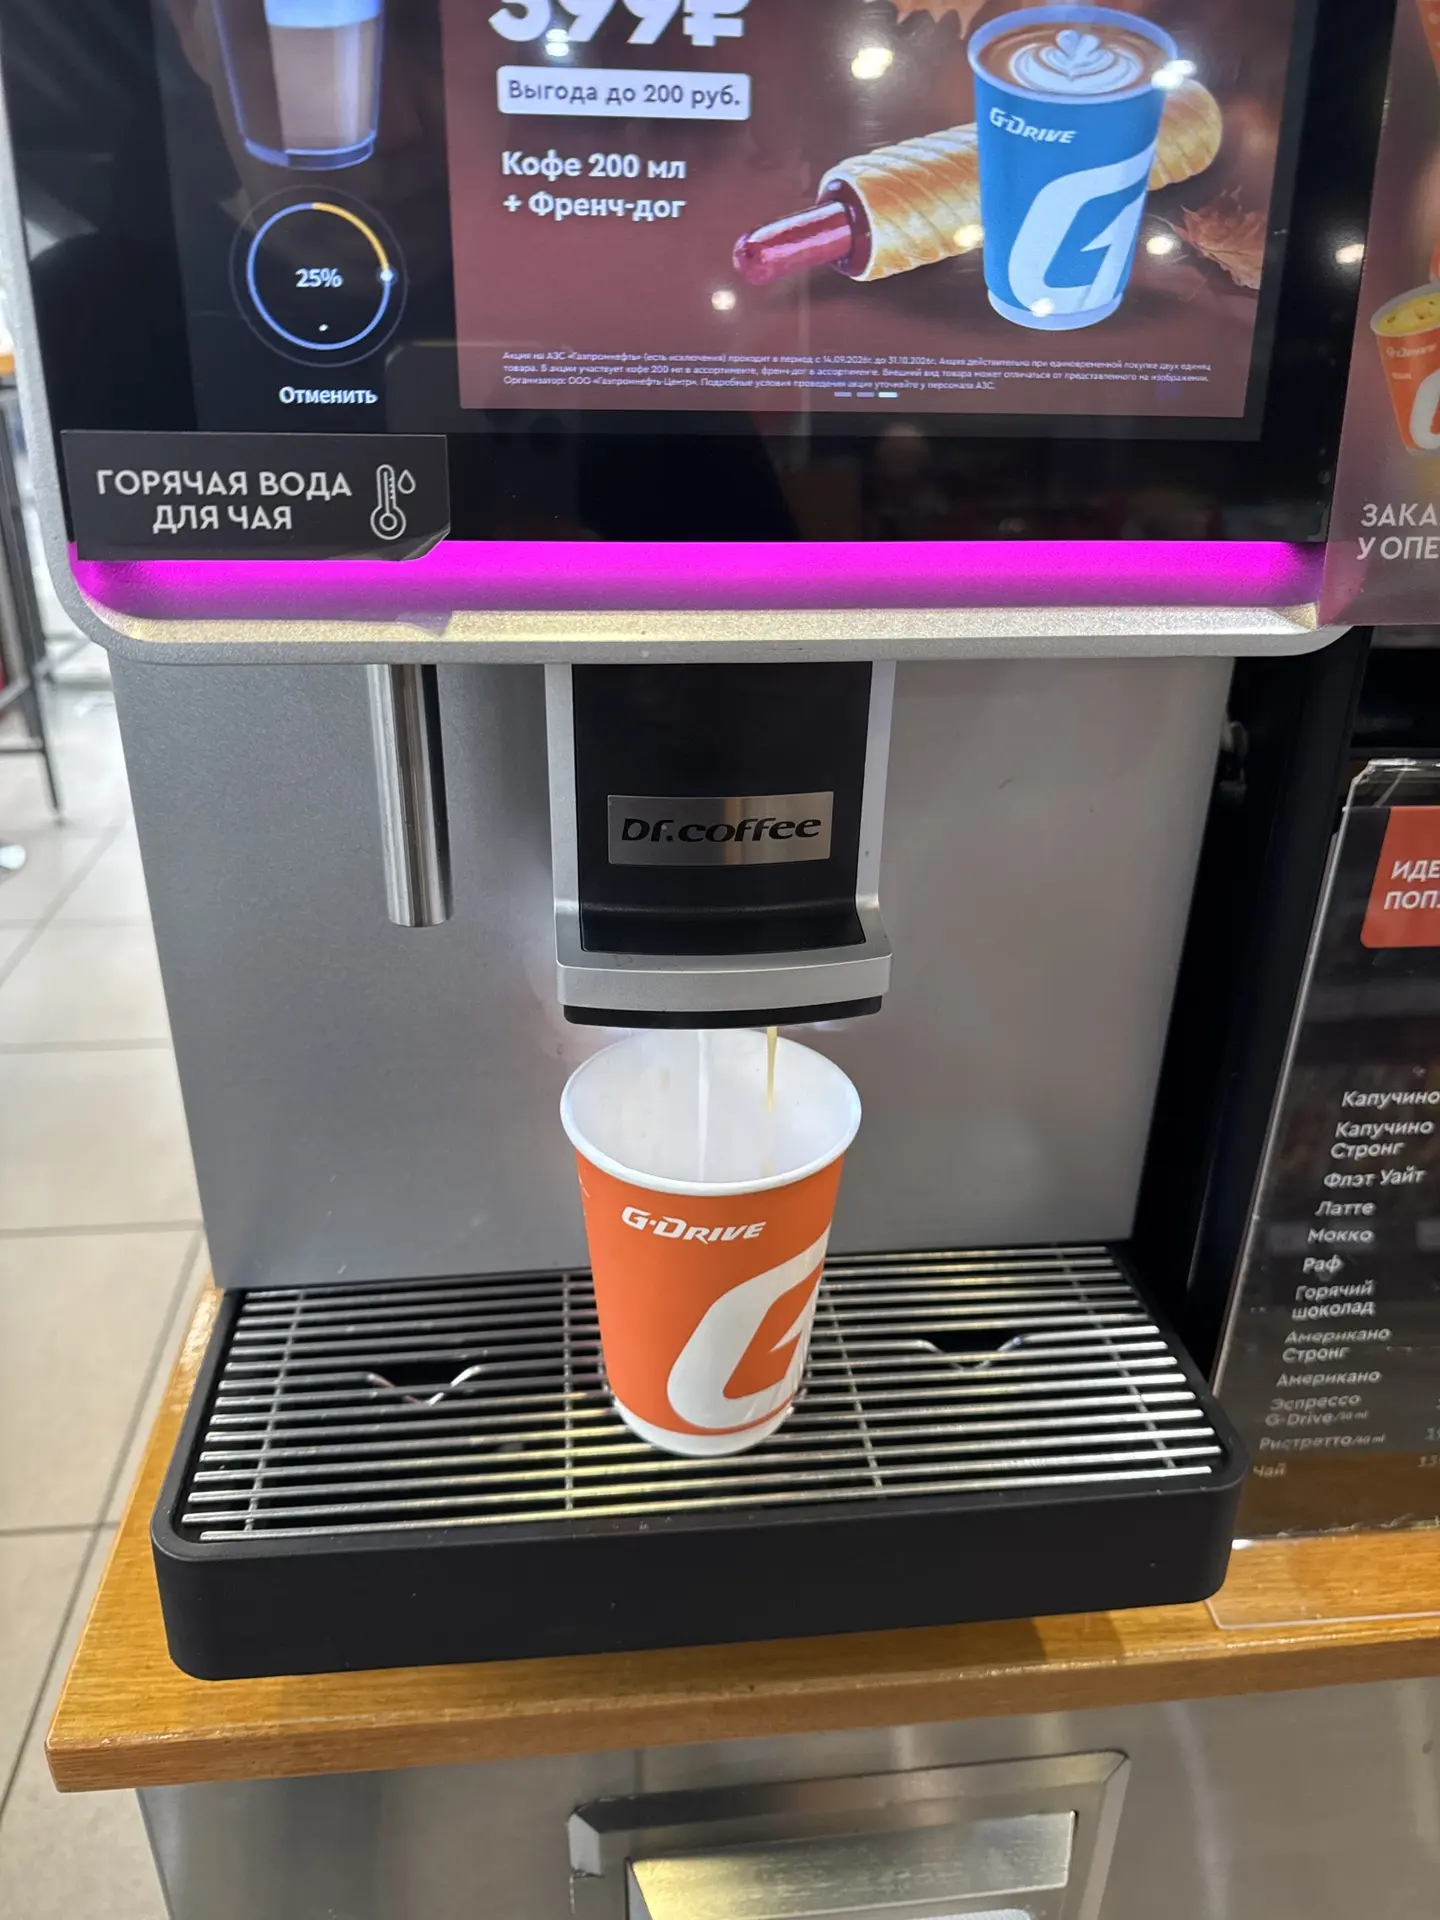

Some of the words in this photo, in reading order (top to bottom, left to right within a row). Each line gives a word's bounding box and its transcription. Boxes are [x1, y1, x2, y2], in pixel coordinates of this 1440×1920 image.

[508, 79, 598, 103] Выгода
[605, 84, 636, 106] до
[643, 84, 684, 104] 200
[691, 84, 741, 109] руб.
[502, 150, 582, 182] Кофе
[588, 153, 640, 179] 200
[647, 160, 687, 180] мл
[528, 191, 688, 222] Френч-дог
[295, 268, 343, 288] 25%
[547, 352, 566, 361] АЗС
[651, 365, 670, 374] 200
[568, 377, 592, 385] ООО
[278, 386, 378, 404] Отменить
[96, 469, 249, 496] ГОРЯЧАЯ
[258, 471, 353, 501] ВОДА
[152, 505, 219, 534] ДЛЯ
[227, 505, 293, 530] ЧАЯ
[1360, 503, 1440, 527] ЗАКА
[1356, 536, 1377, 560] У
[621, 817, 822, 842] Dr.coffee
[1384, 890, 1440, 910] ПОП
[1341, 1090, 1440, 1110] Капучино
[1335, 1121, 1434, 1140] Капучино
[1330, 1142, 1405, 1160] Стронг
[1323, 1171, 1376, 1188] Флэт
[1379, 1166, 1427, 1185] Уайт
[1314, 1200, 1376, 1217] Латте
[1307, 1228, 1375, 1243] Мокко
[1302, 1254, 1344, 1273] Раф
[1296, 1279, 1374, 1301] Горячий
[1291, 1301, 1376, 1321] шоколад
[1284, 1328, 1391, 1344] Американо
[1282, 1347, 1349, 1364] Стронг
[1276, 1370, 1381, 1387] Американо
[1270, 1394, 1361, 1412] Эспрессо
[1253, 1462, 1287, 1478] Чай
